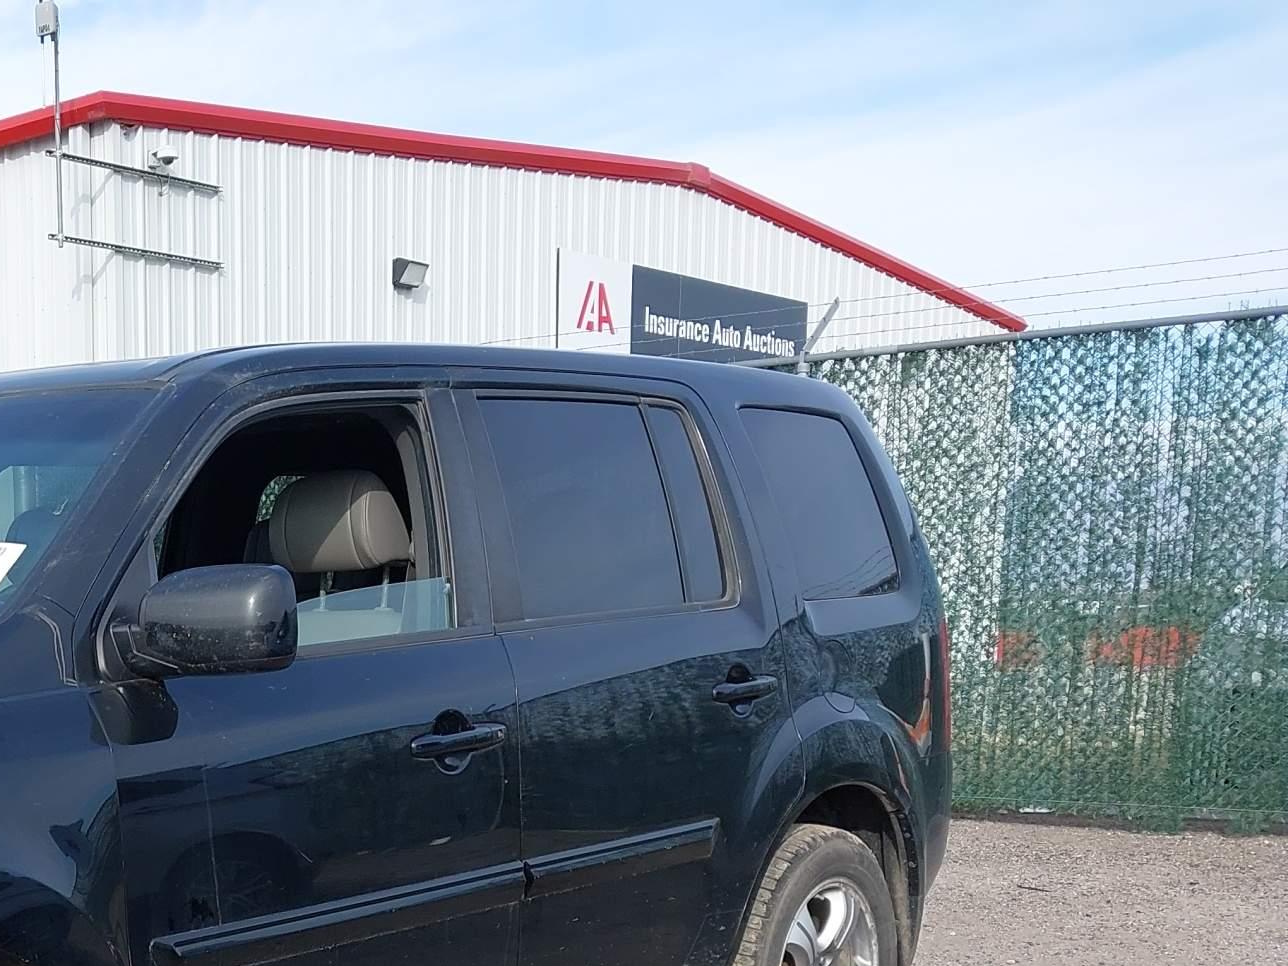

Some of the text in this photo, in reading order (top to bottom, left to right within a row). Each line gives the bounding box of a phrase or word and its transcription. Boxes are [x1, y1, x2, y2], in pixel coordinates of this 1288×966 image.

[645, 306, 795, 357] Insurance Auto Auctions
